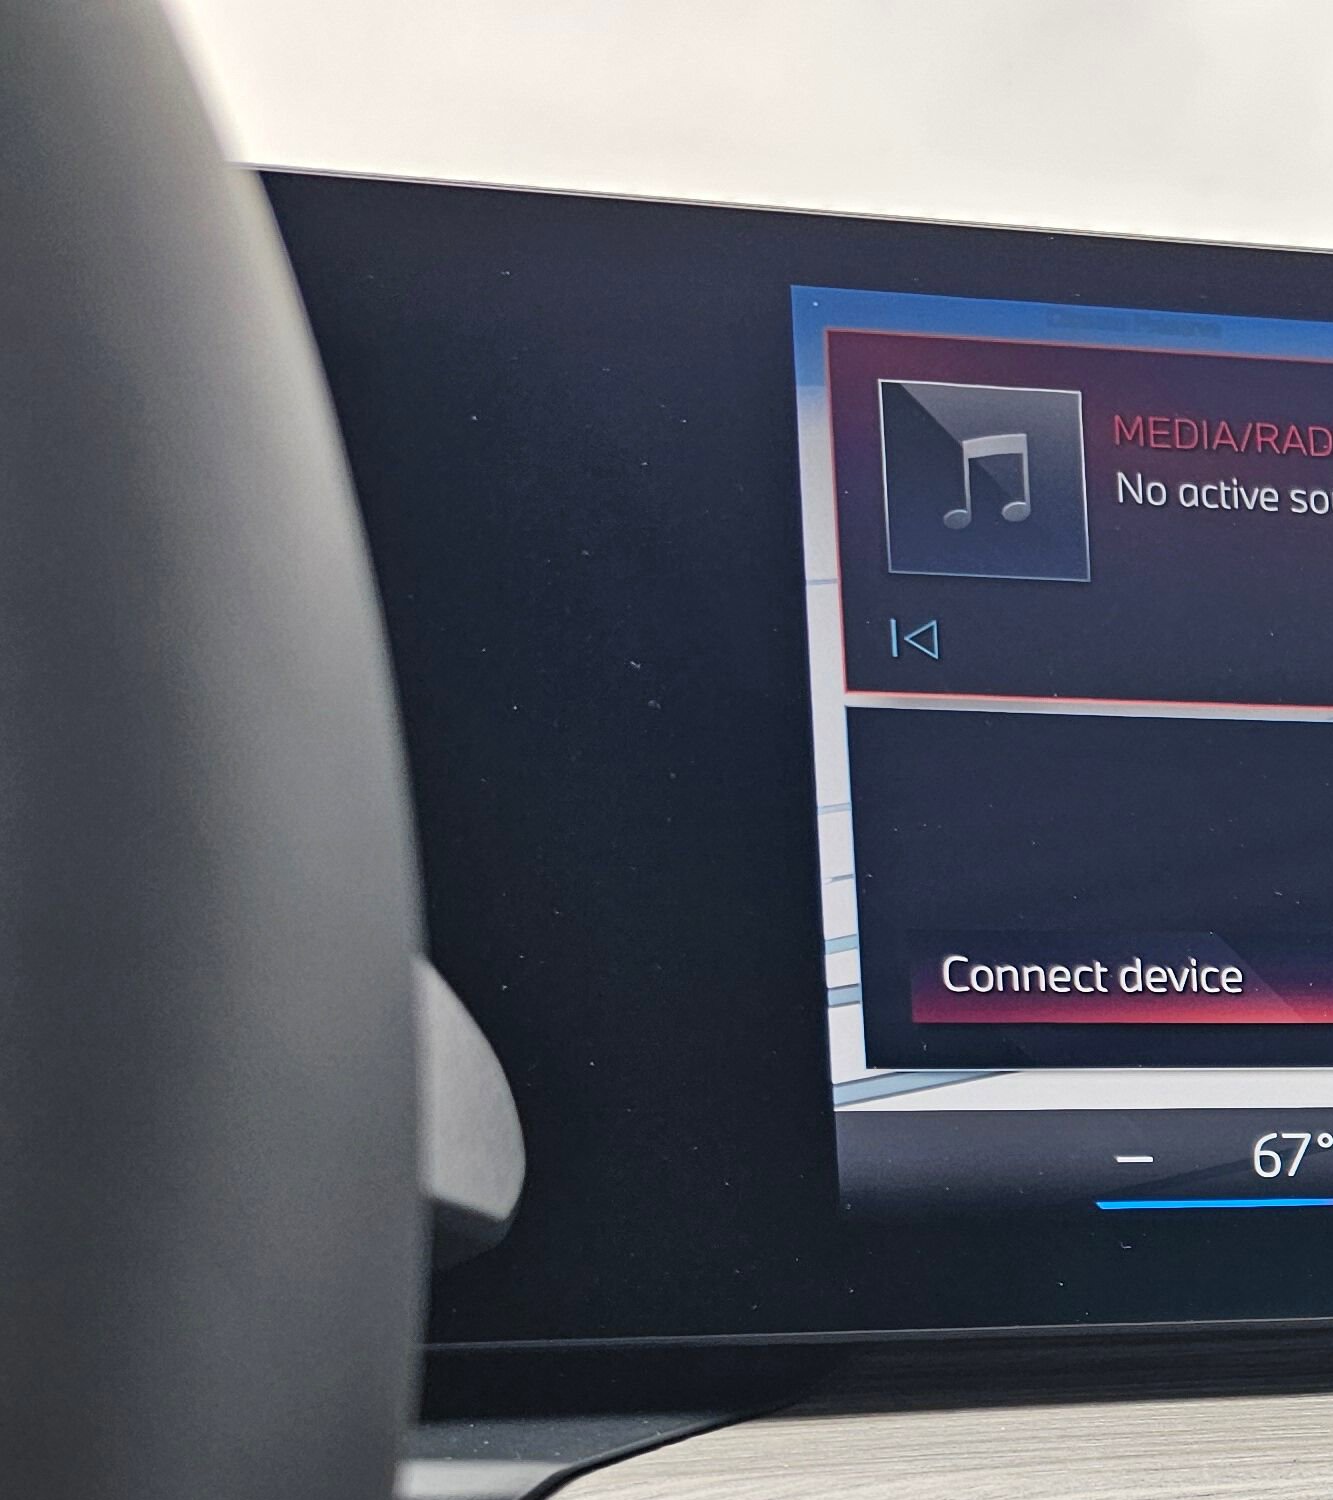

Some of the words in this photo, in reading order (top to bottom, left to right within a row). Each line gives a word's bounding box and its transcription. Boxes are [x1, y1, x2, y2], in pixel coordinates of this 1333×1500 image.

[1116, 470, 1168, 506] No
[1178, 477, 1280, 512] active
[942, 954, 1109, 993] Connect
[1118, 956, 1244, 993] device
